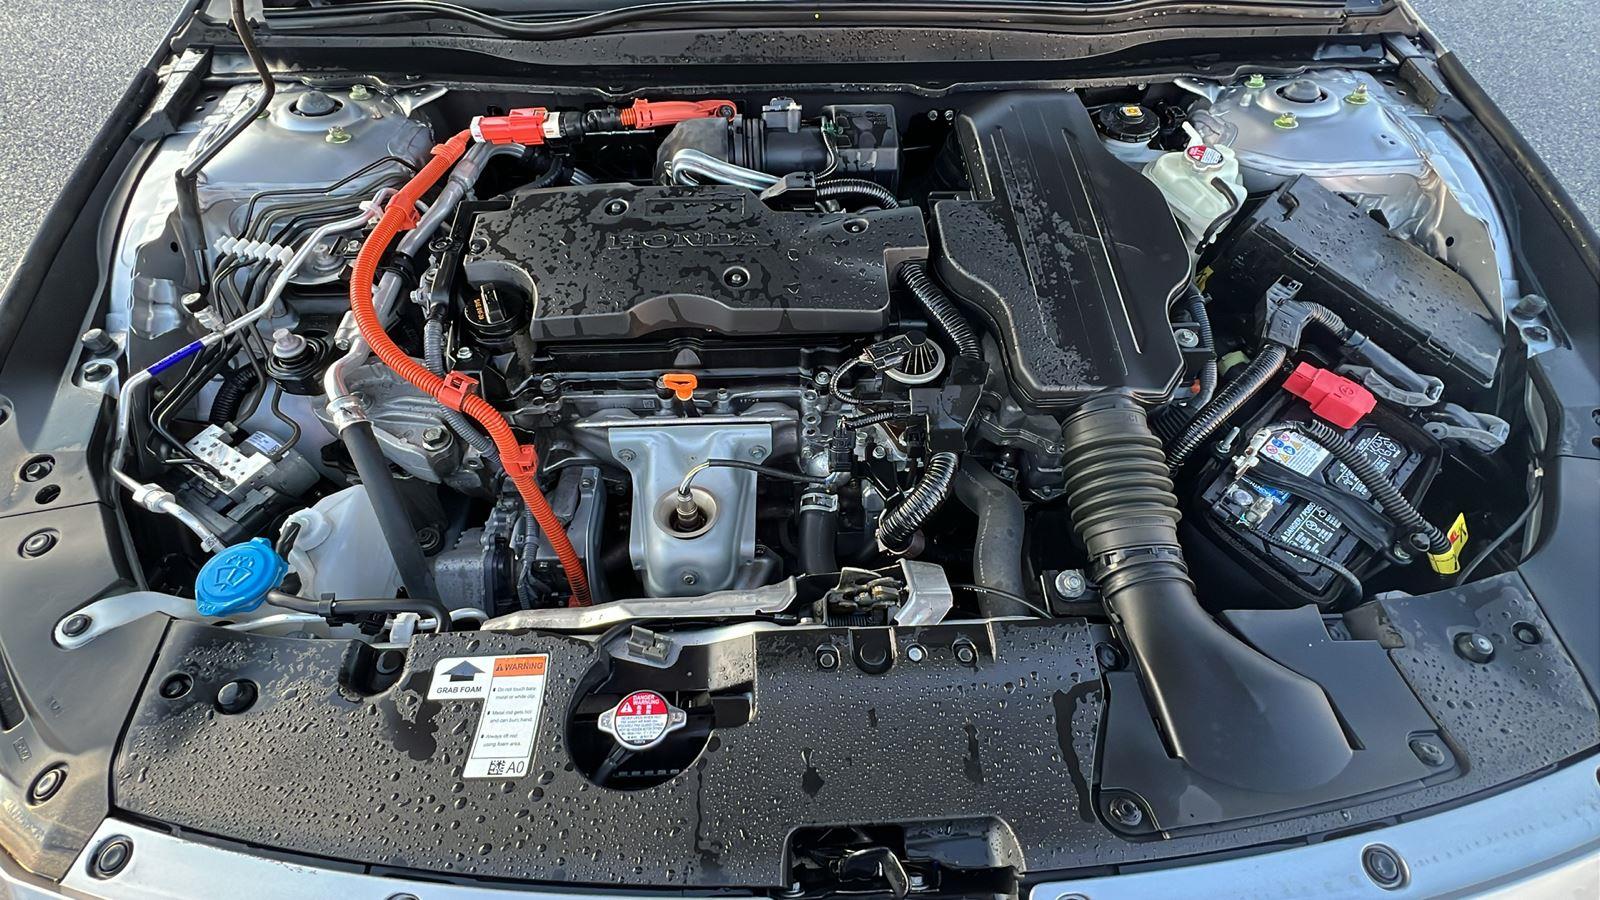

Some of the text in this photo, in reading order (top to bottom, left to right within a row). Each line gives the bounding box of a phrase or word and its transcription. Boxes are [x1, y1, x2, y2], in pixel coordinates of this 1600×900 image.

[608, 231, 774, 249] HONDA
[1284, 517, 1302, 537] DANGER
[1302, 502, 1315, 517] POISO
[505, 662, 543, 671] WARNING
[436, 686, 459, 694] GRAB
[506, 761, 525, 773] A0
